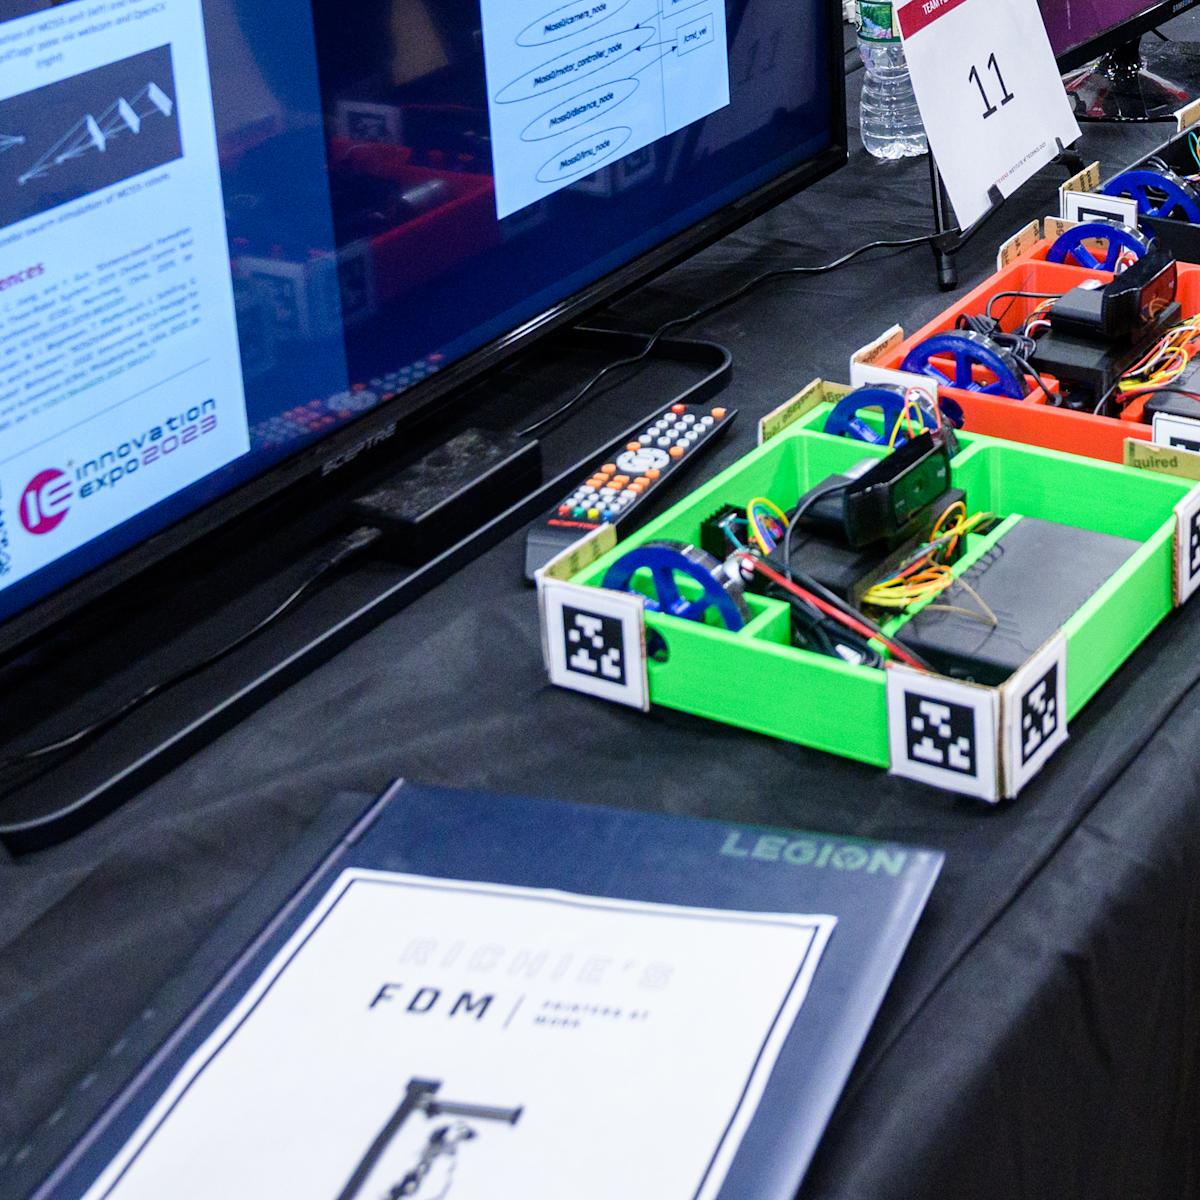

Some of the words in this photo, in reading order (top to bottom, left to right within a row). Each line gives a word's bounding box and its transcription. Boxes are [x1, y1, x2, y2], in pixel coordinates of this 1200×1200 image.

[968, 52, 1015, 120] 11
[75, 398, 217, 481] innovation
[720, 830, 908, 877] LEGION
[368, 983, 495, 1021] FDM
